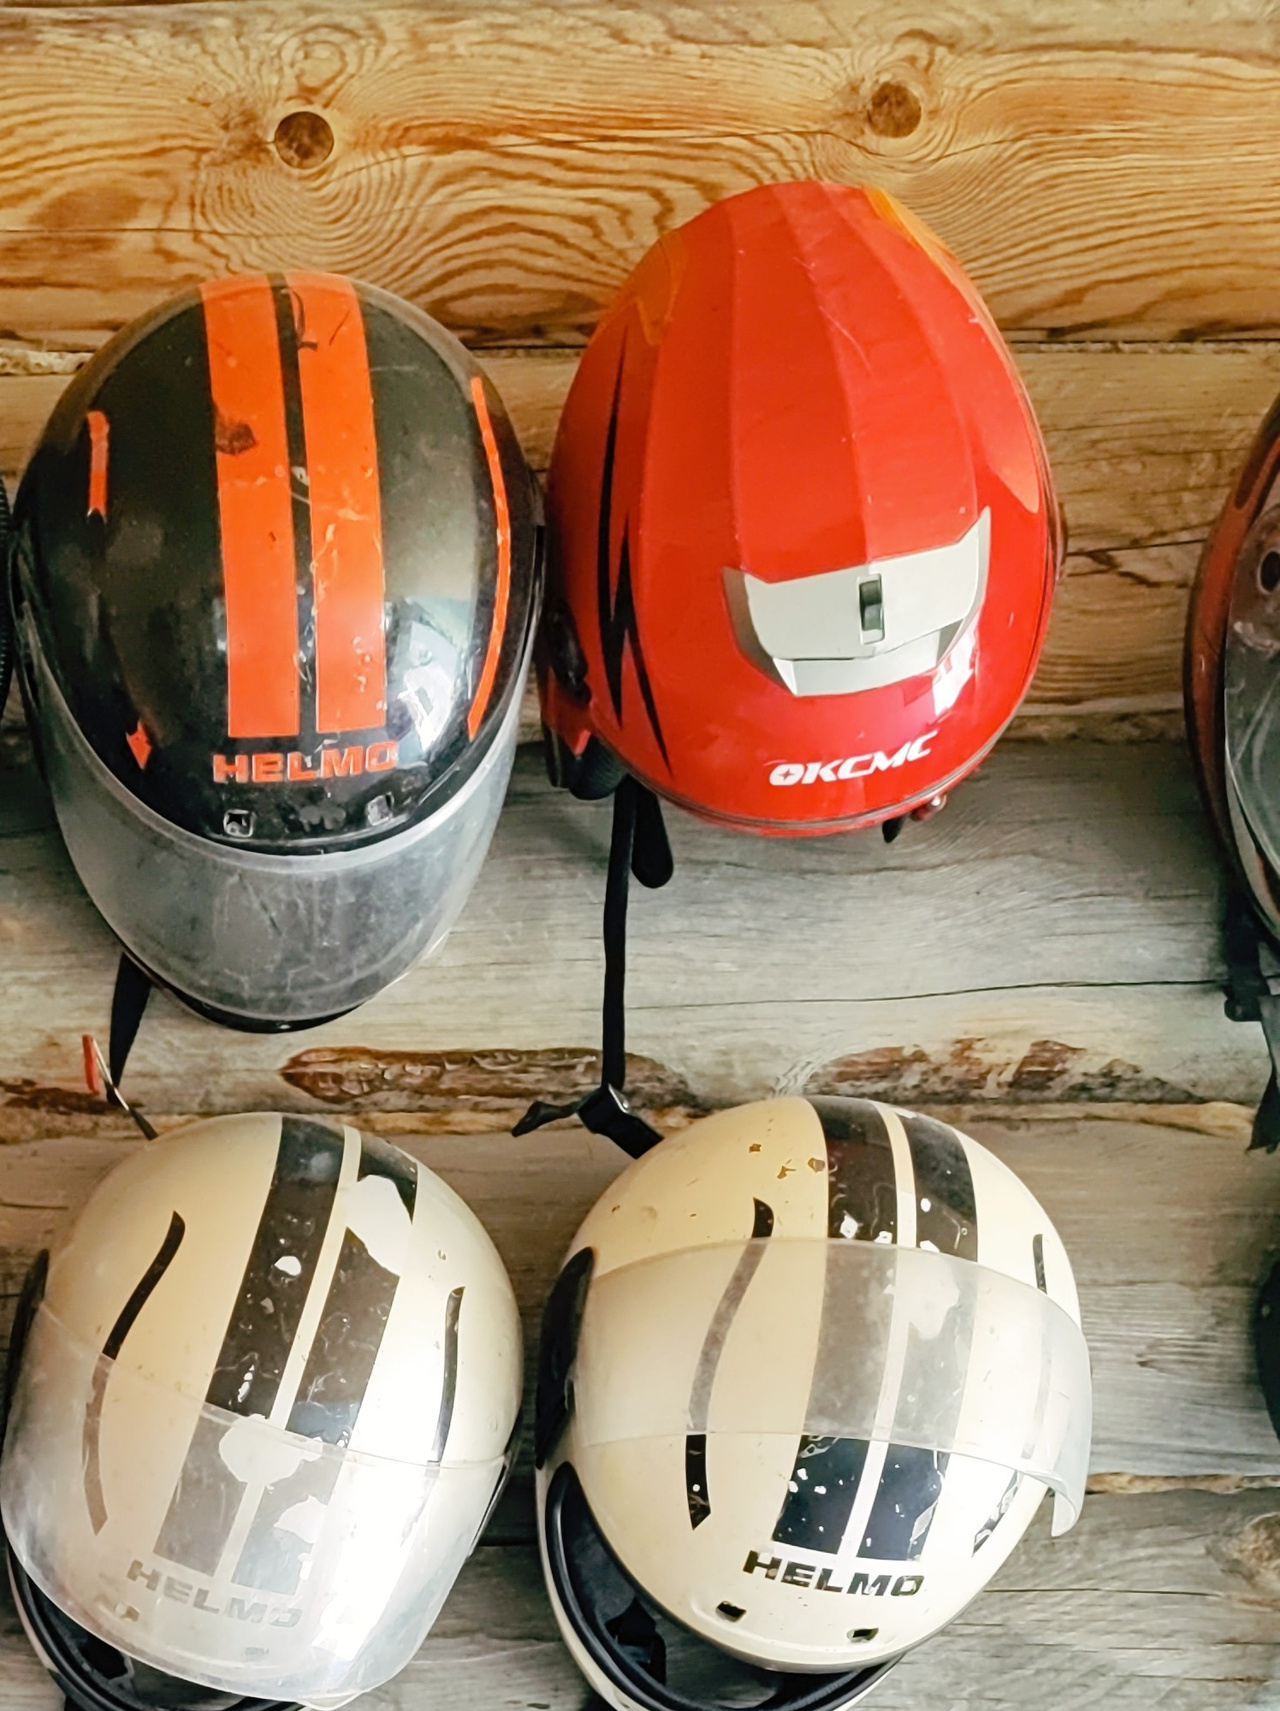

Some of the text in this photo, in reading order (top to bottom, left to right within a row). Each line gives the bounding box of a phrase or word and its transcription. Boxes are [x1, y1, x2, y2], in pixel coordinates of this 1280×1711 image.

[213, 740, 399, 784] HELMO
[769, 729, 938, 786] OKCMC
[127, 1559, 303, 1628] HELMO
[743, 1550, 925, 1597] HELMO
